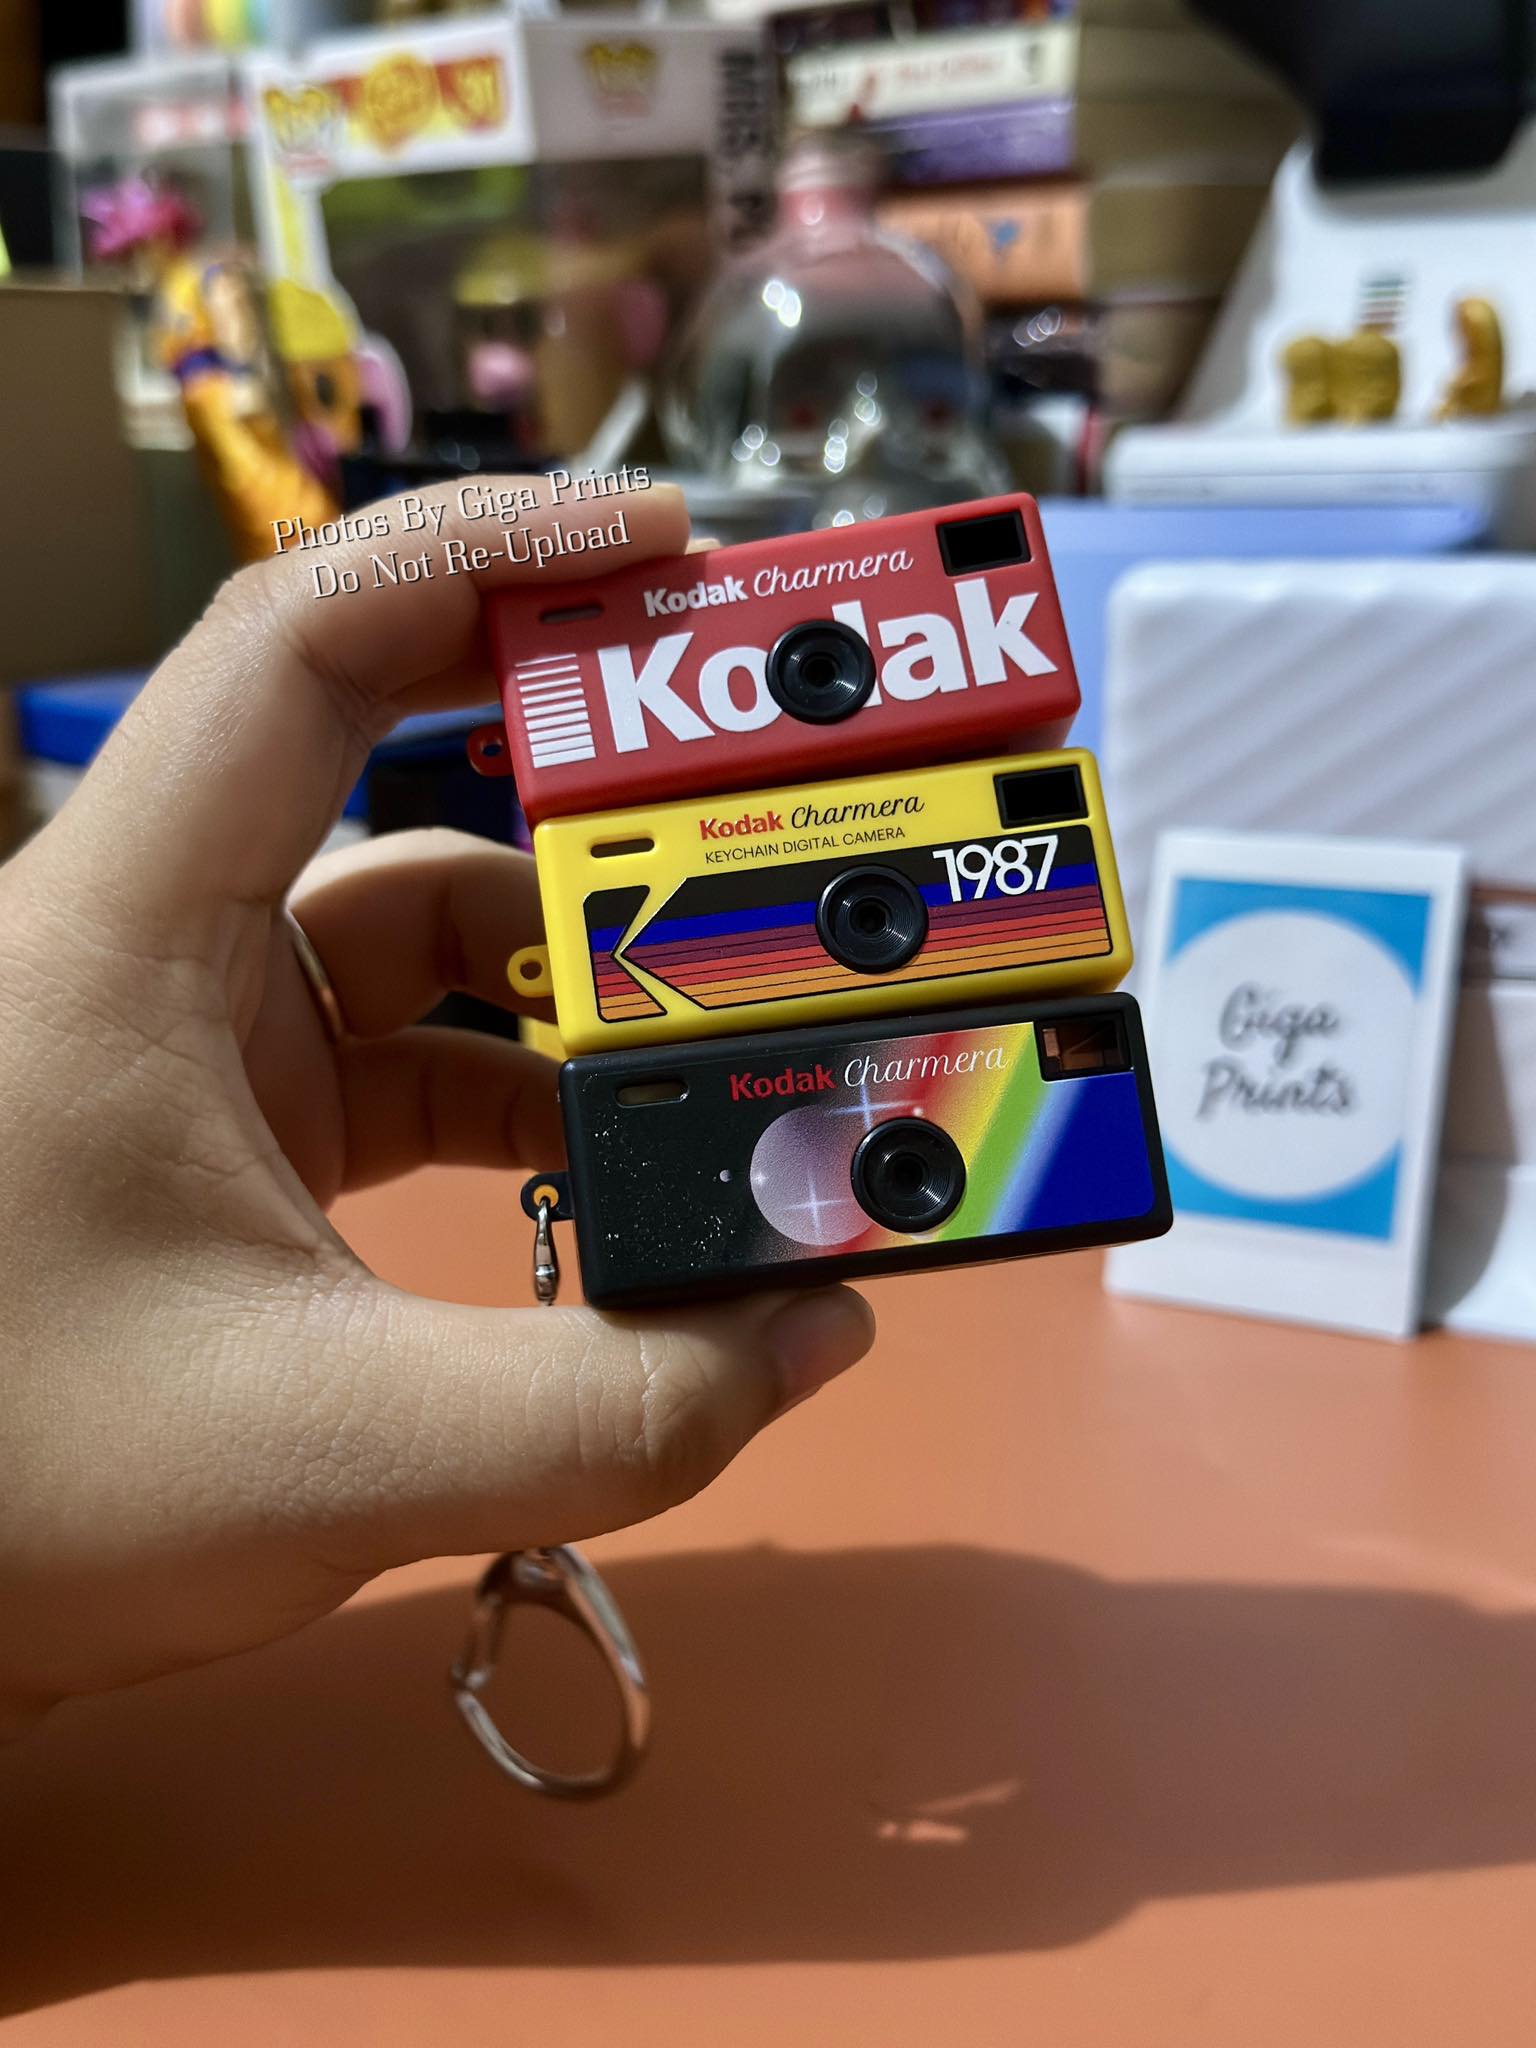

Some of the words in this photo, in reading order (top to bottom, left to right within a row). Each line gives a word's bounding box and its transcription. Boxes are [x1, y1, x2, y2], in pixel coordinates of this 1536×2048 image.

[643, 575, 749, 618] Kodak
[753, 548, 914, 598] Charmera
[699, 810, 784, 841] Kodak
[790, 795, 925, 829] Charmera
[705, 843, 780, 864] KEYCHAIN
[782, 835, 840, 855] DIGITAL
[841, 826, 906, 847] CAMERA
[932, 834, 1059, 902] 1987
[1218, 979, 1342, 1068] Giga
[729, 1063, 836, 1101] Kodak
[844, 1046, 1009, 1088] Charmera
[1195, 1056, 1355, 1122] Prints
